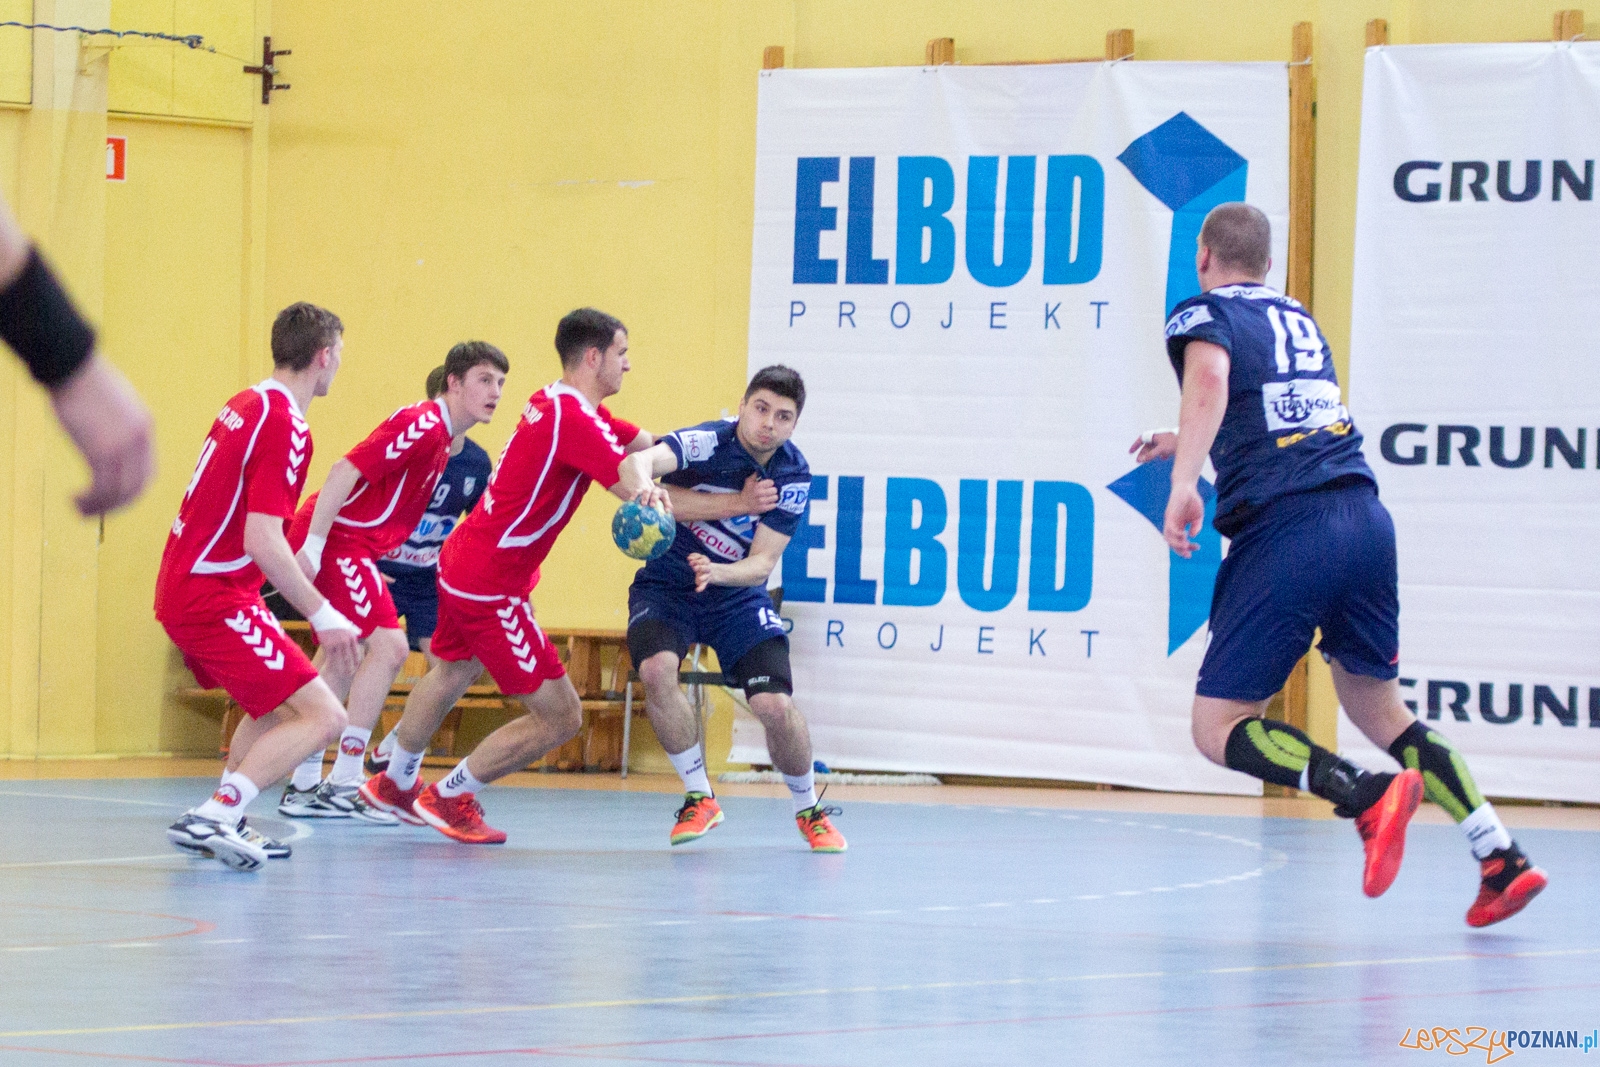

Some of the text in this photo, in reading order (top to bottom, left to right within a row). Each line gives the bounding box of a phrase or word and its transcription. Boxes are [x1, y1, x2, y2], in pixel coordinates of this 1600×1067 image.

[1393, 159, 1596, 203] GRUN
[792, 154, 1105, 287] ELBUD
[789, 301, 1109, 329] PROJEKT
[1266, 305, 1325, 374] 19
[1380, 422, 1600, 470] GRUN
[781, 475, 1094, 612] ELBUD
[1399, 677, 1600, 729] RUN
